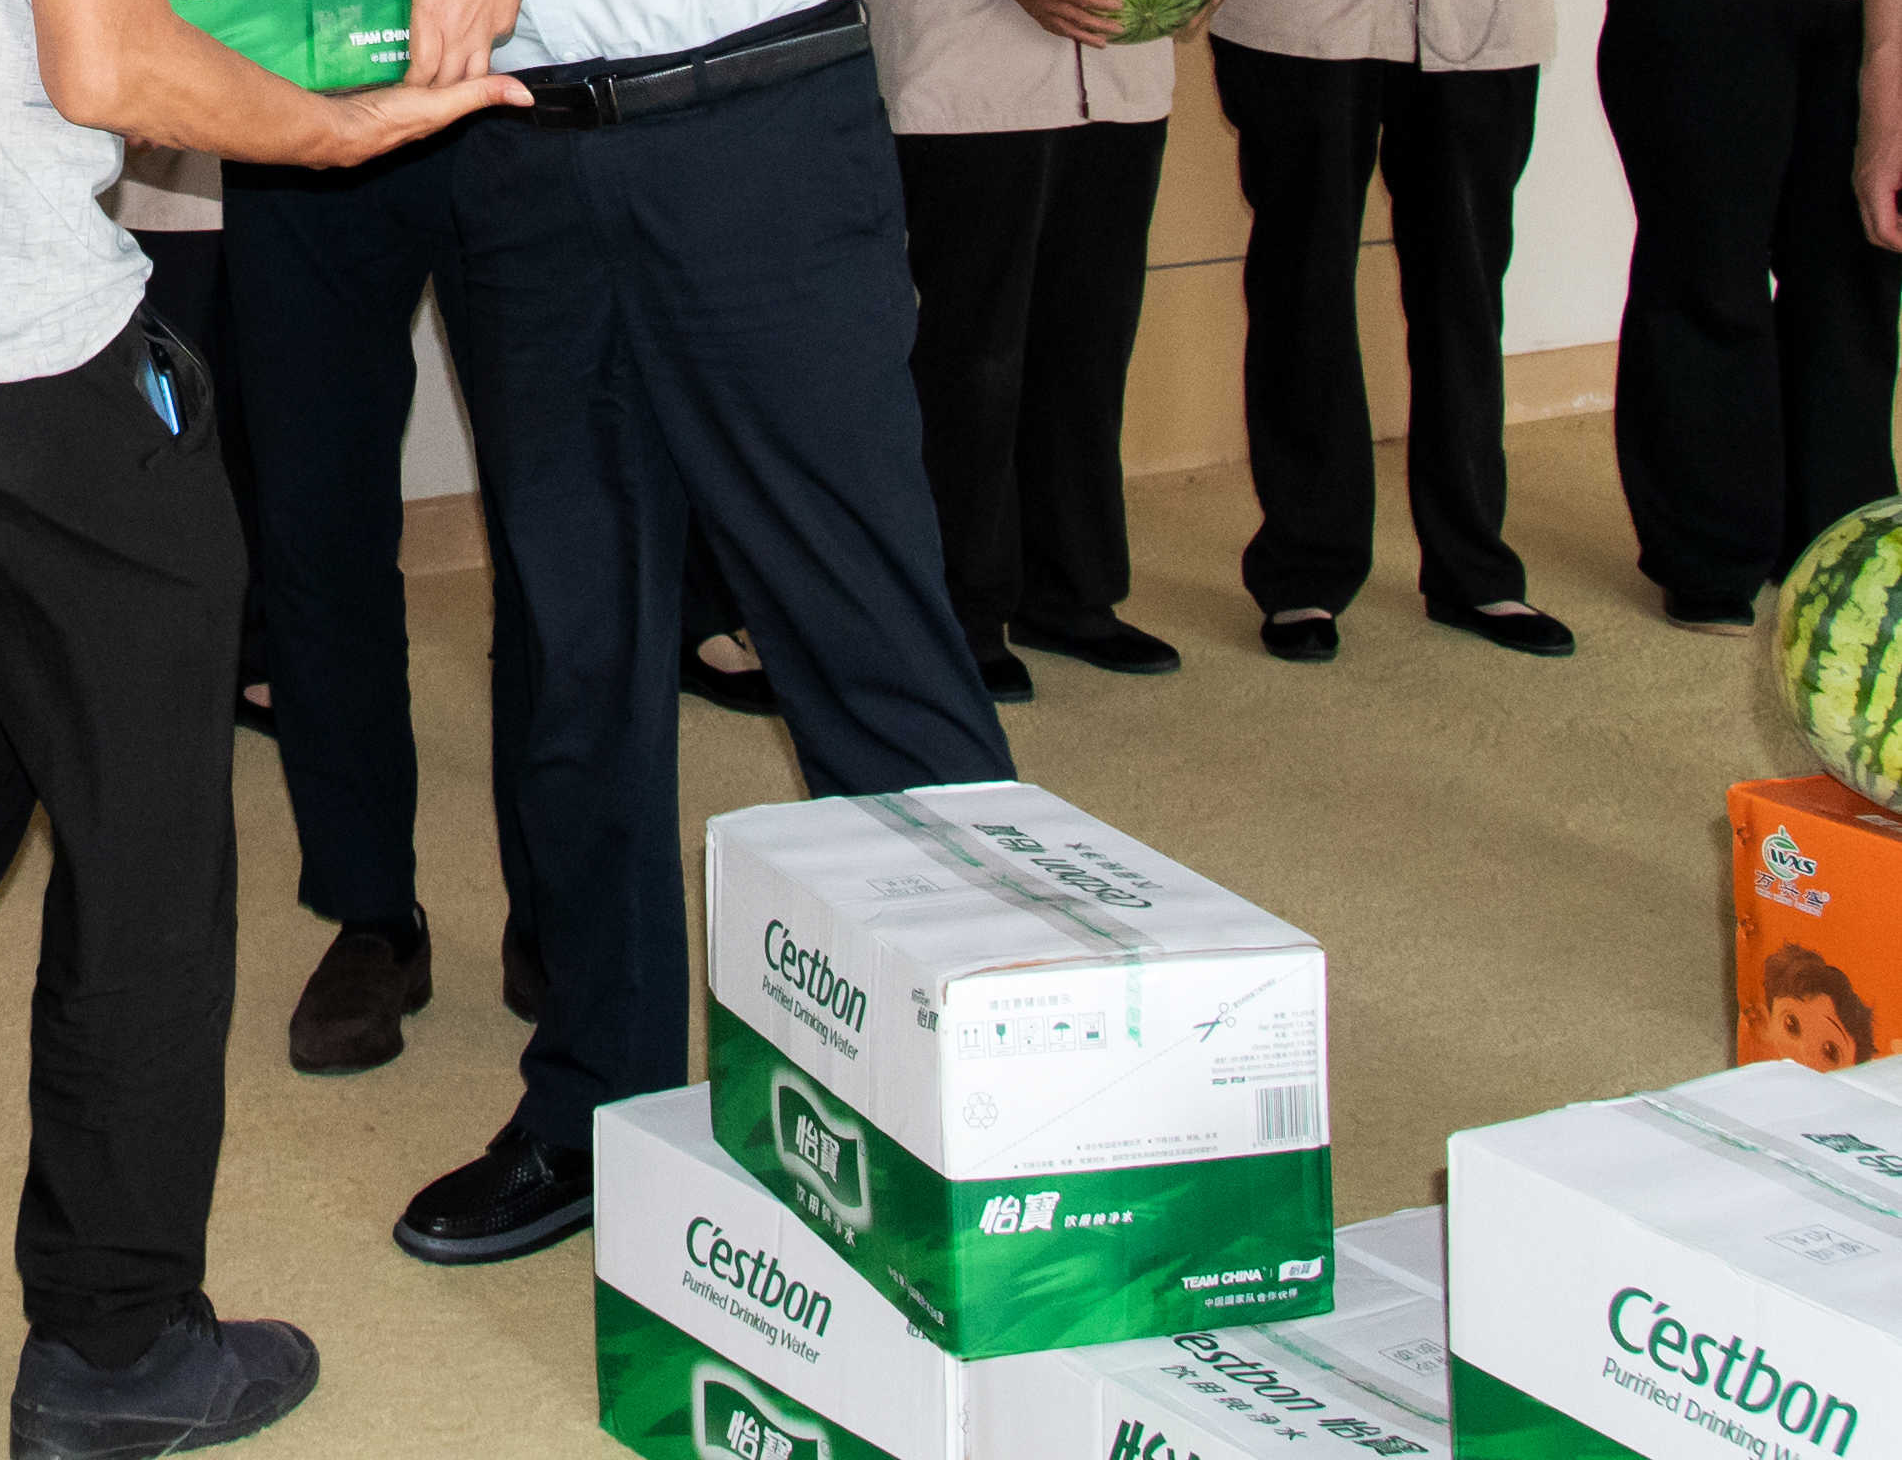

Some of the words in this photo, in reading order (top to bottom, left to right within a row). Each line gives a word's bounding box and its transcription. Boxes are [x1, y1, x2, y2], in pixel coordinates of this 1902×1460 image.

[349, 31, 381, 47] TEAM
[382, 29, 411, 43] CHIN
[762, 974, 793, 1013] Purified
[793, 1000, 829, 1046] Drinking
[830, 1027, 858, 1061] Water
[682, 1270, 729, 1310] Purified
[729, 1298, 779, 1346] Drinking
[780, 1328, 820, 1365] Water
[1181, 1273, 1219, 1290] TEAM
[1221, 1268, 1263, 1285] CHINA
[1601, 1355, 1682, 1414] Purified
[1684, 1398, 1768, 1460] Drinking
